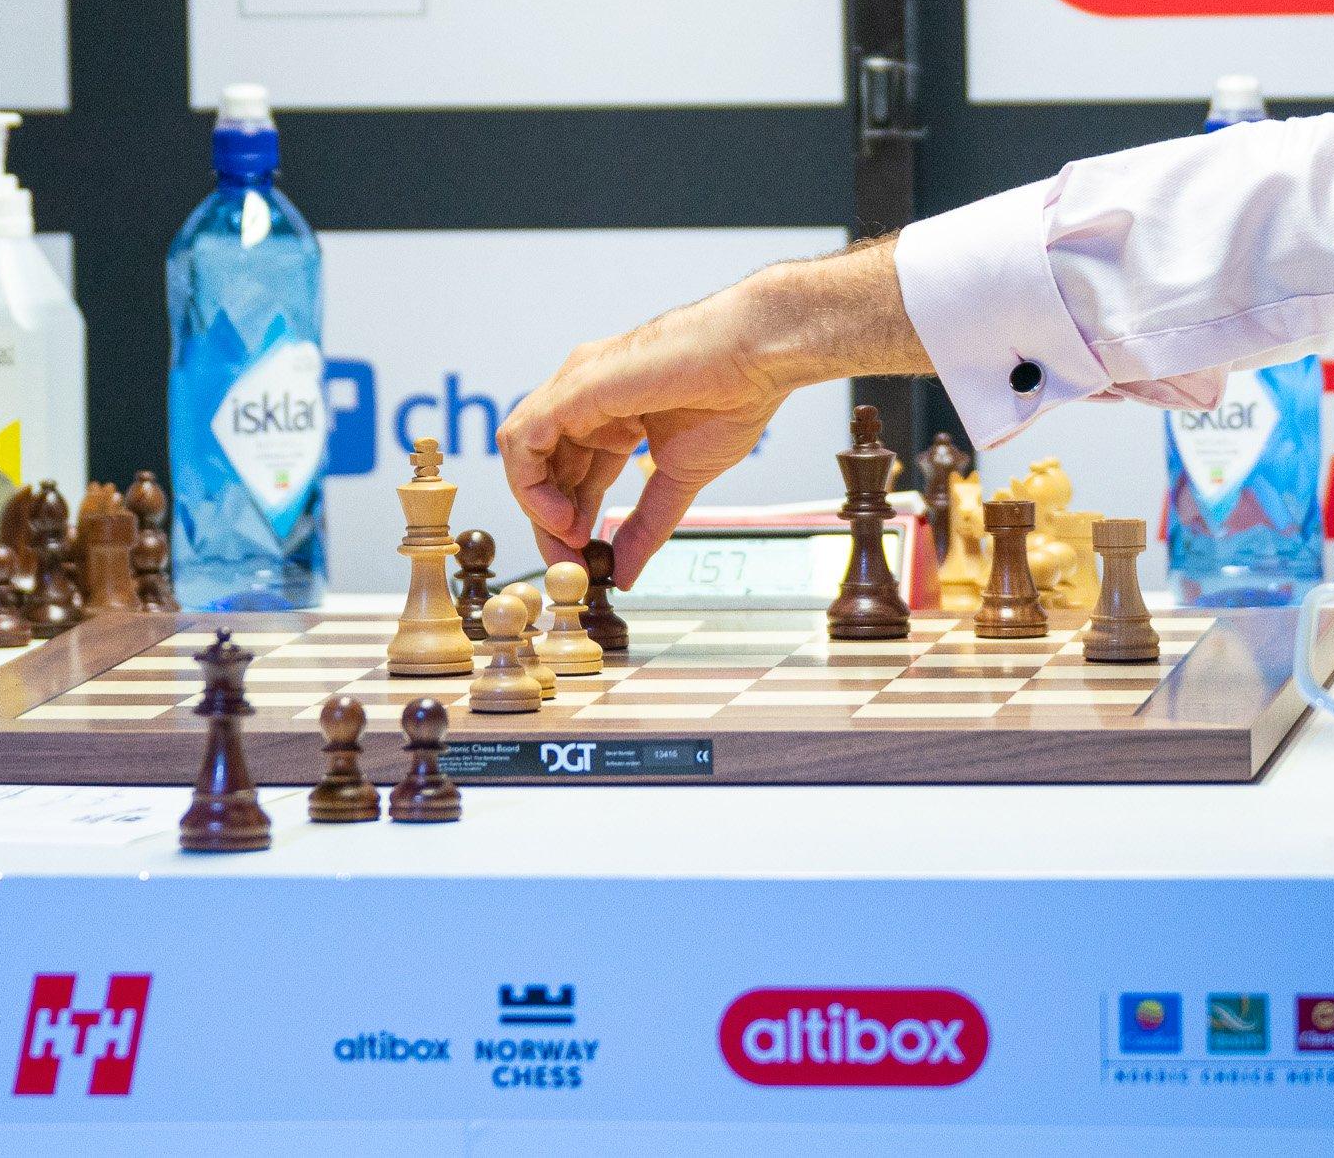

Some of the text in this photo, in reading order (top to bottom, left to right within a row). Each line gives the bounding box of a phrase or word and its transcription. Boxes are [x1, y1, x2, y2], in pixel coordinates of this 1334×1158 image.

[540, 743, 597, 772] DGT
[333, 1030, 451, 1063] altibox
[741, 1002, 966, 1065] altibox
[474, 1039, 599, 1062] NORWAY
[491, 1064, 583, 1089] CHESS
